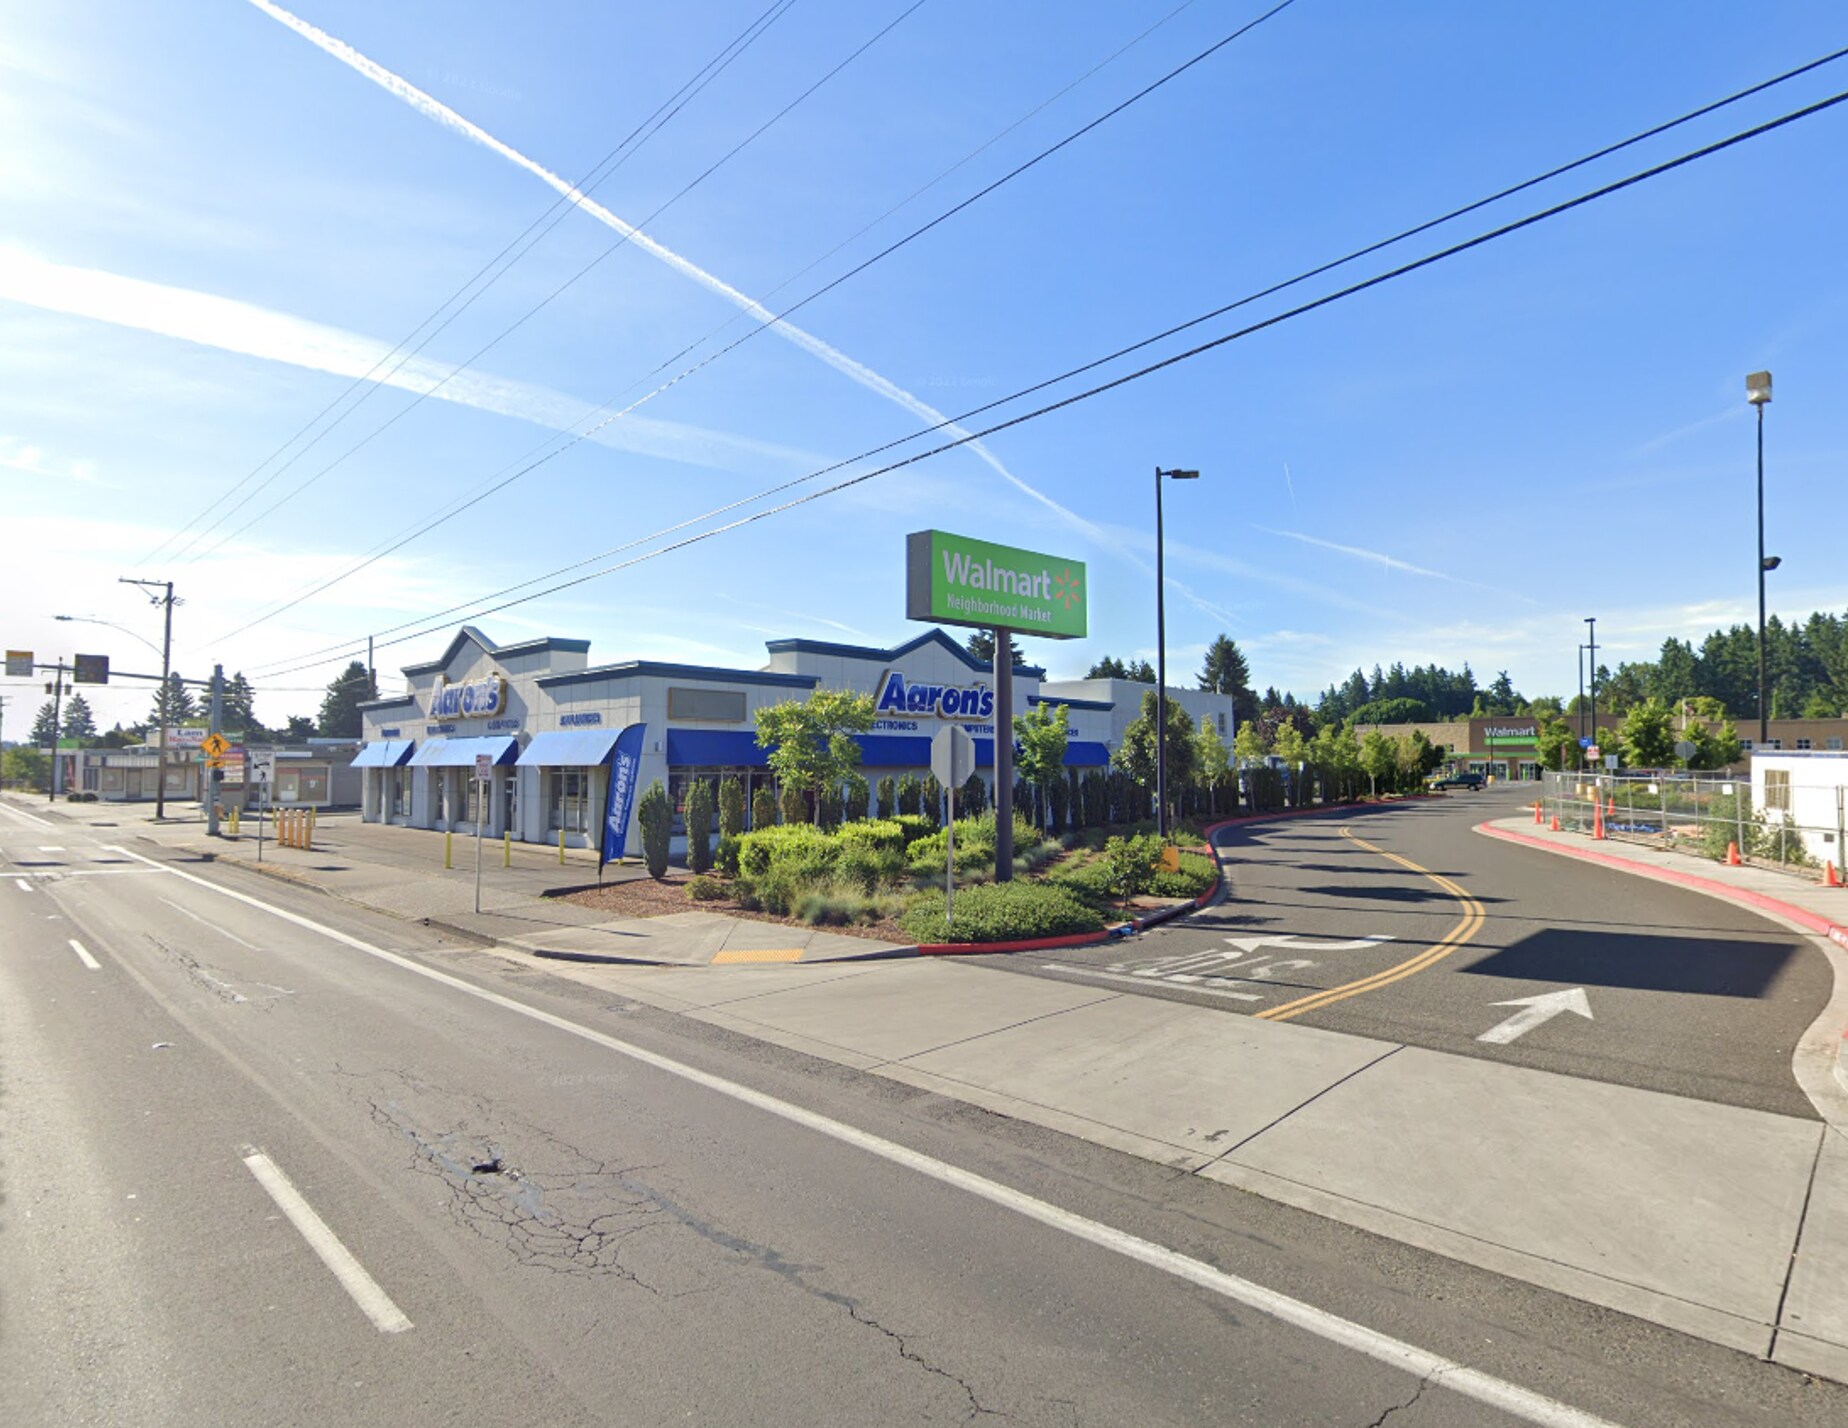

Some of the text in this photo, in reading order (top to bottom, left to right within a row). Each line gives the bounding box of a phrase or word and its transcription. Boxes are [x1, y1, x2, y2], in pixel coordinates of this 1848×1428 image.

[943, 550, 1051, 600] Walmart
[947, 593, 1052, 622] Neighborhood Market
[430, 675, 500, 716] Aaron's
[878, 672, 993, 717] Aaron's
[872, 720, 918, 730] ECTRONICS
[1484, 726, 1535, 736] Walmart
[608, 754, 632, 834] Aaron's
